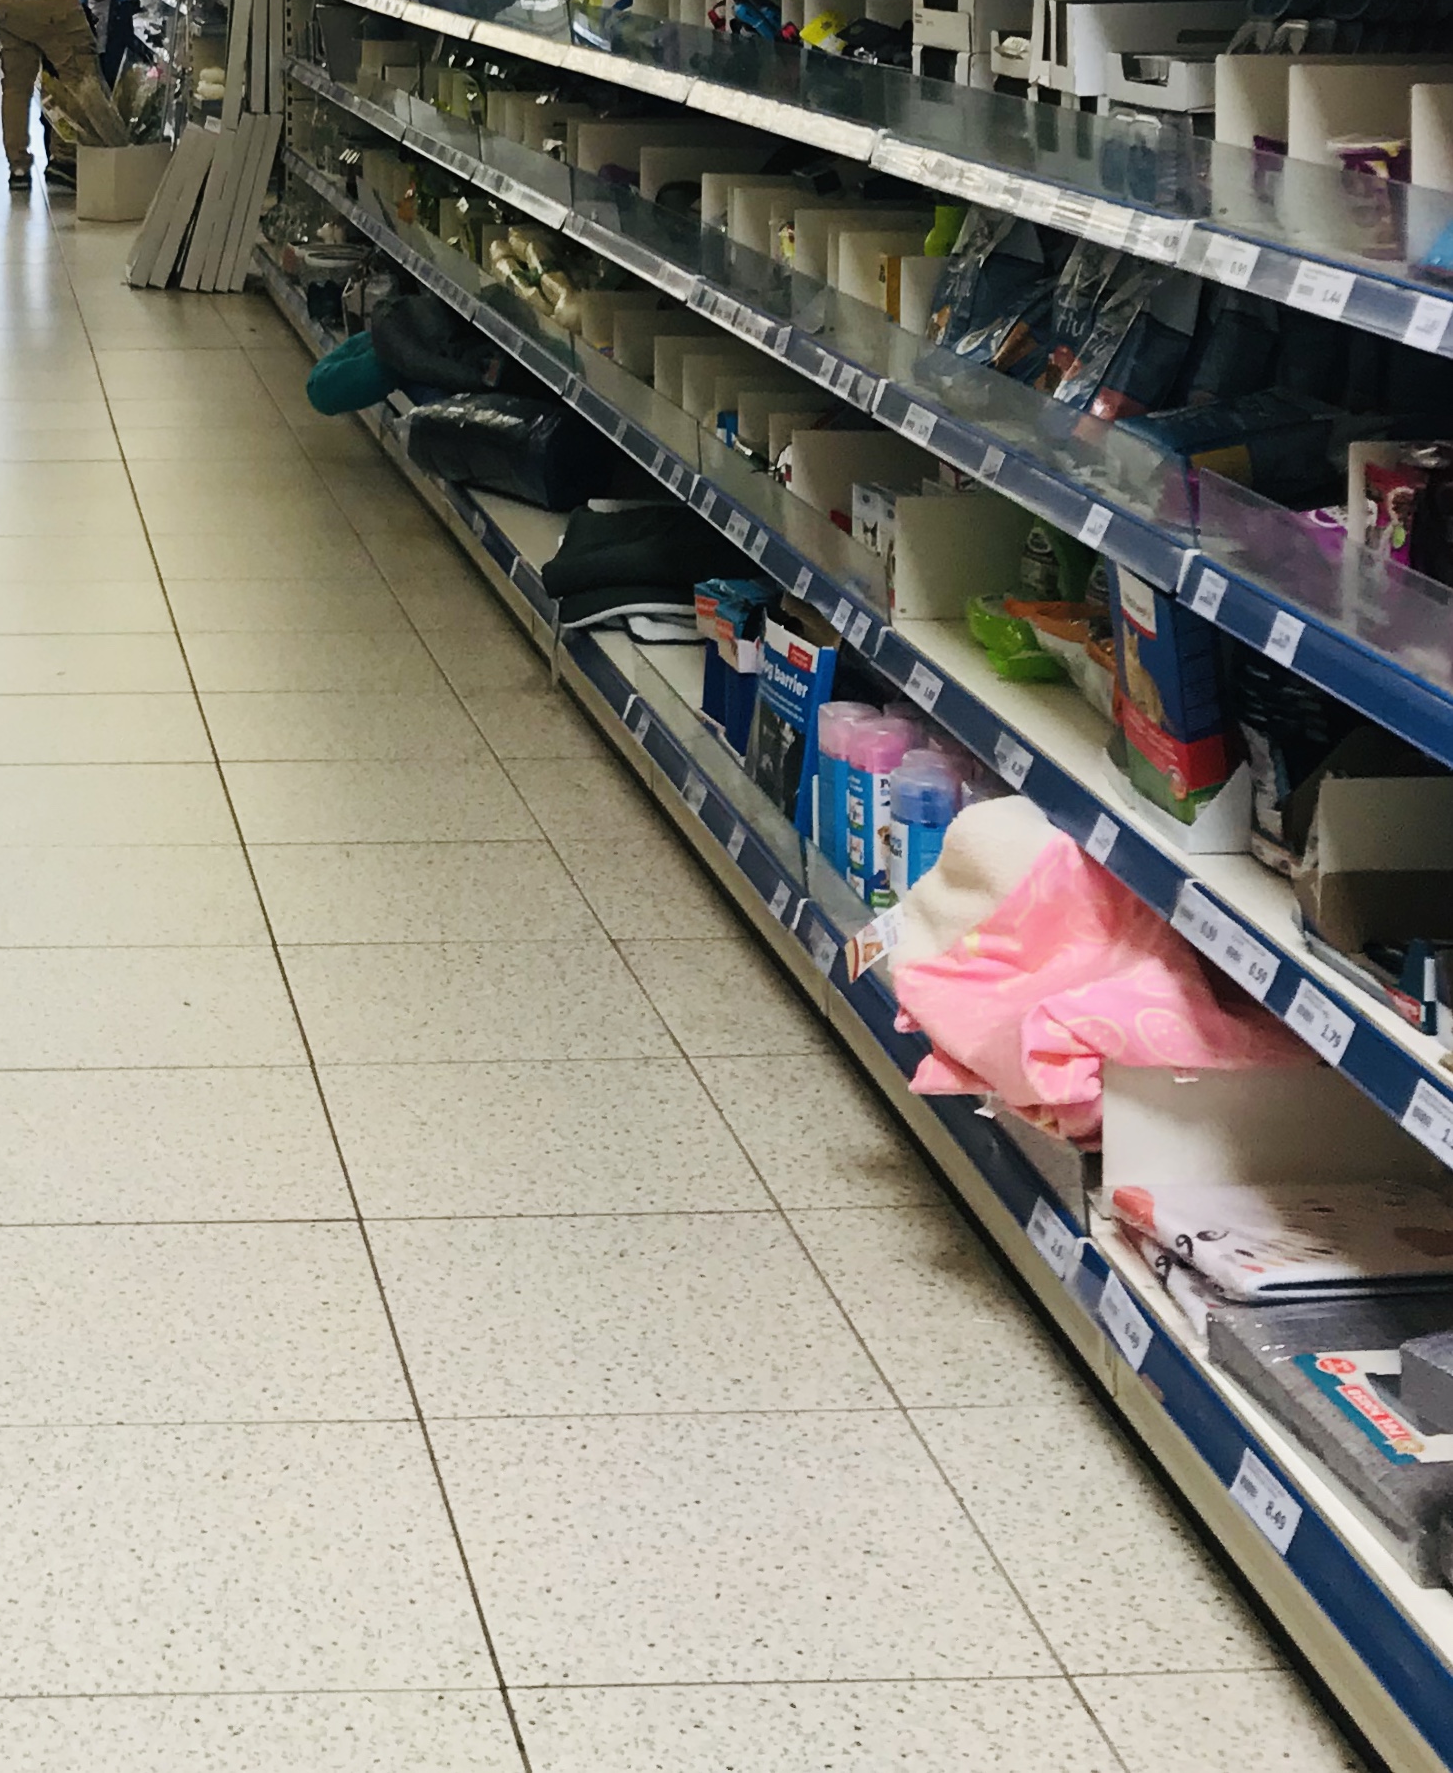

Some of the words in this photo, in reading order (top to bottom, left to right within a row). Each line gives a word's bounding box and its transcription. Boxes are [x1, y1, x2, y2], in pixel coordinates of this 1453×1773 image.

[774, 663, 809, 698] barrier
[1320, 1023, 1342, 1049] 1.79
[1265, 1499, 1287, 1531] 8.49
